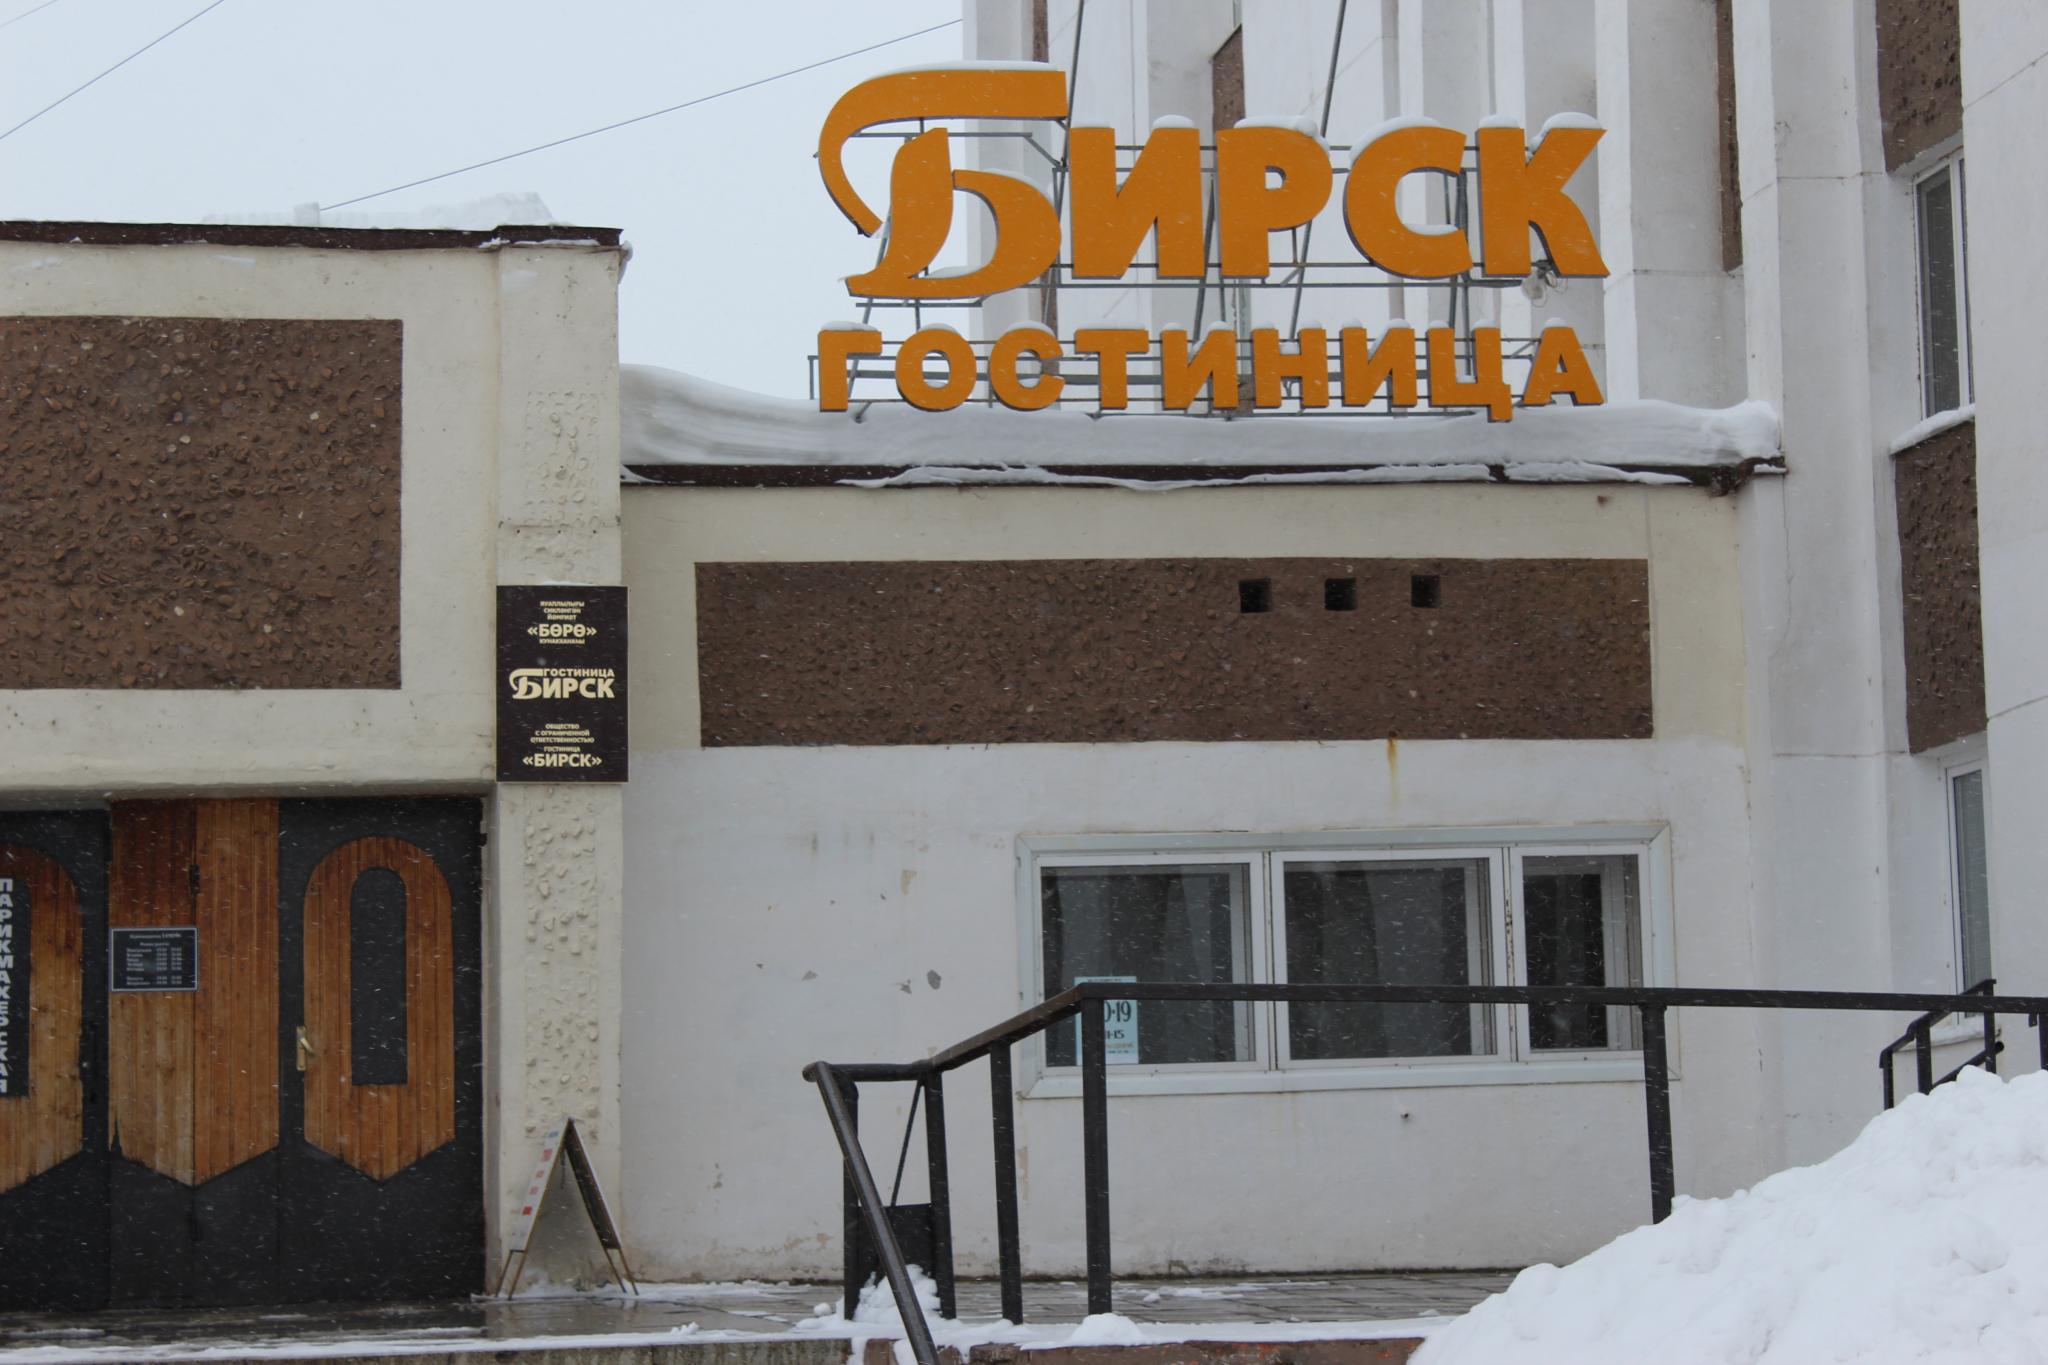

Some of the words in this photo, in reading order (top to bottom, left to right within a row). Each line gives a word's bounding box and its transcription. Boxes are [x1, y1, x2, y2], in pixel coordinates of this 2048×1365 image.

[817, 68, 1610, 299] БИРСК
[818, 327, 1605, 423] ГОСТИНИЦА
[509, 668, 615, 700] БИРСК
[543, 668, 615, 678] ГОСТИНИЦА
[522, 753, 602, 767] «БИРСК»
